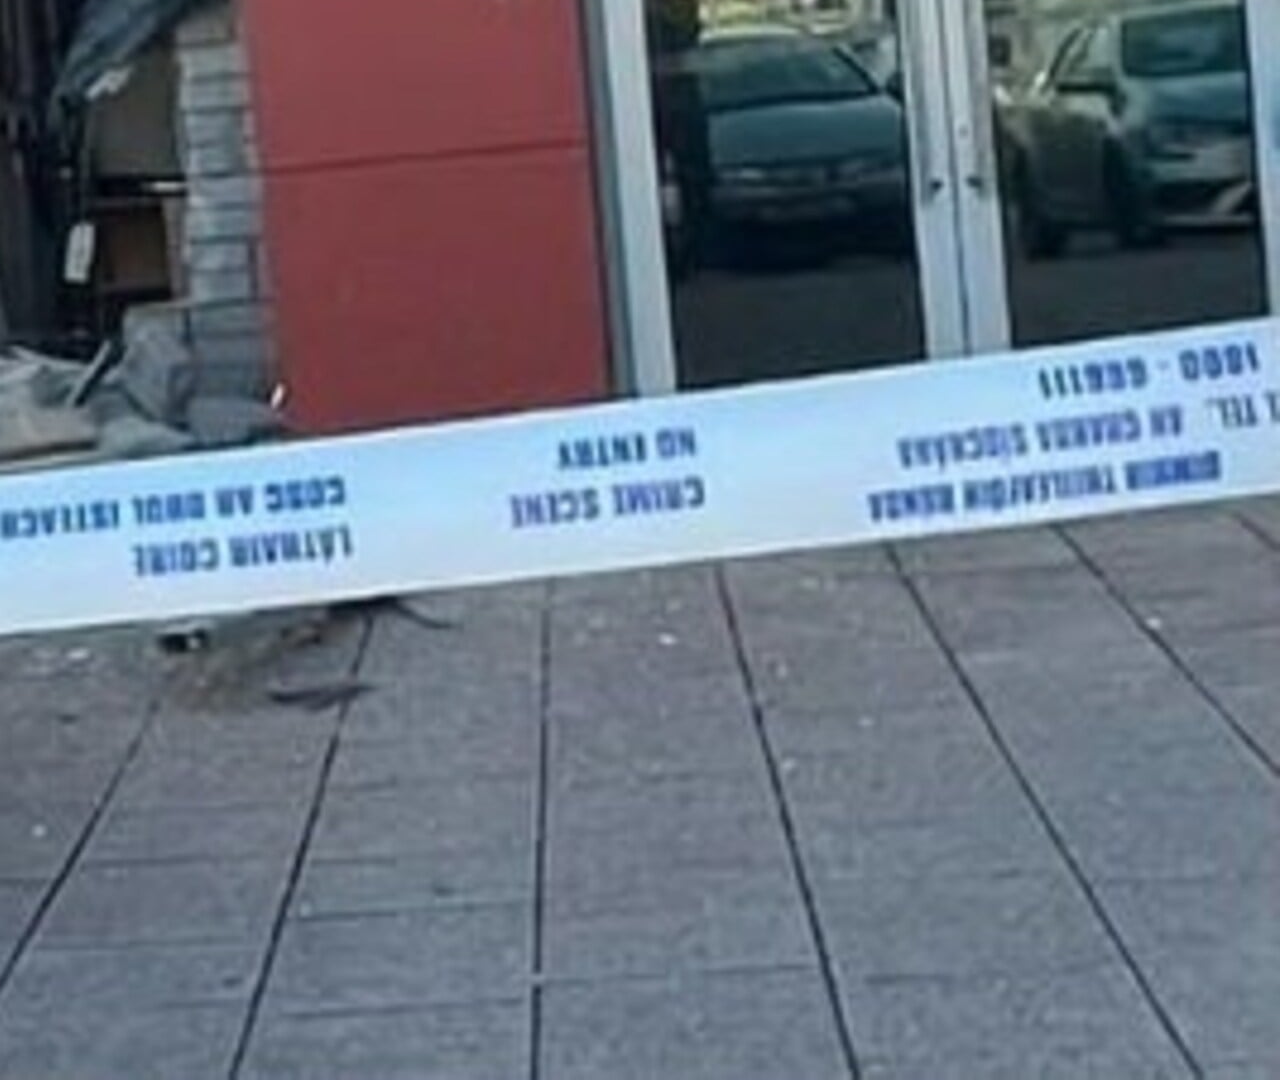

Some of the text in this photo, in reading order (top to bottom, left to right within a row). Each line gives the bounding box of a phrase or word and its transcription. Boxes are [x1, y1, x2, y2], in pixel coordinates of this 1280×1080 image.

[1038, 356, 1148, 399] 666111
[1179, 343, 1259, 381] 1800
[558, 428, 696, 470] NO ENTRY
[214, 485, 254, 517] AR
[265, 476, 345, 512] COSC
[508, 476, 705, 529] CRIME SCENE
[0, 499, 120, 540] ISTEACH
[131, 523, 352, 577] LÁTHAIR COIRE
